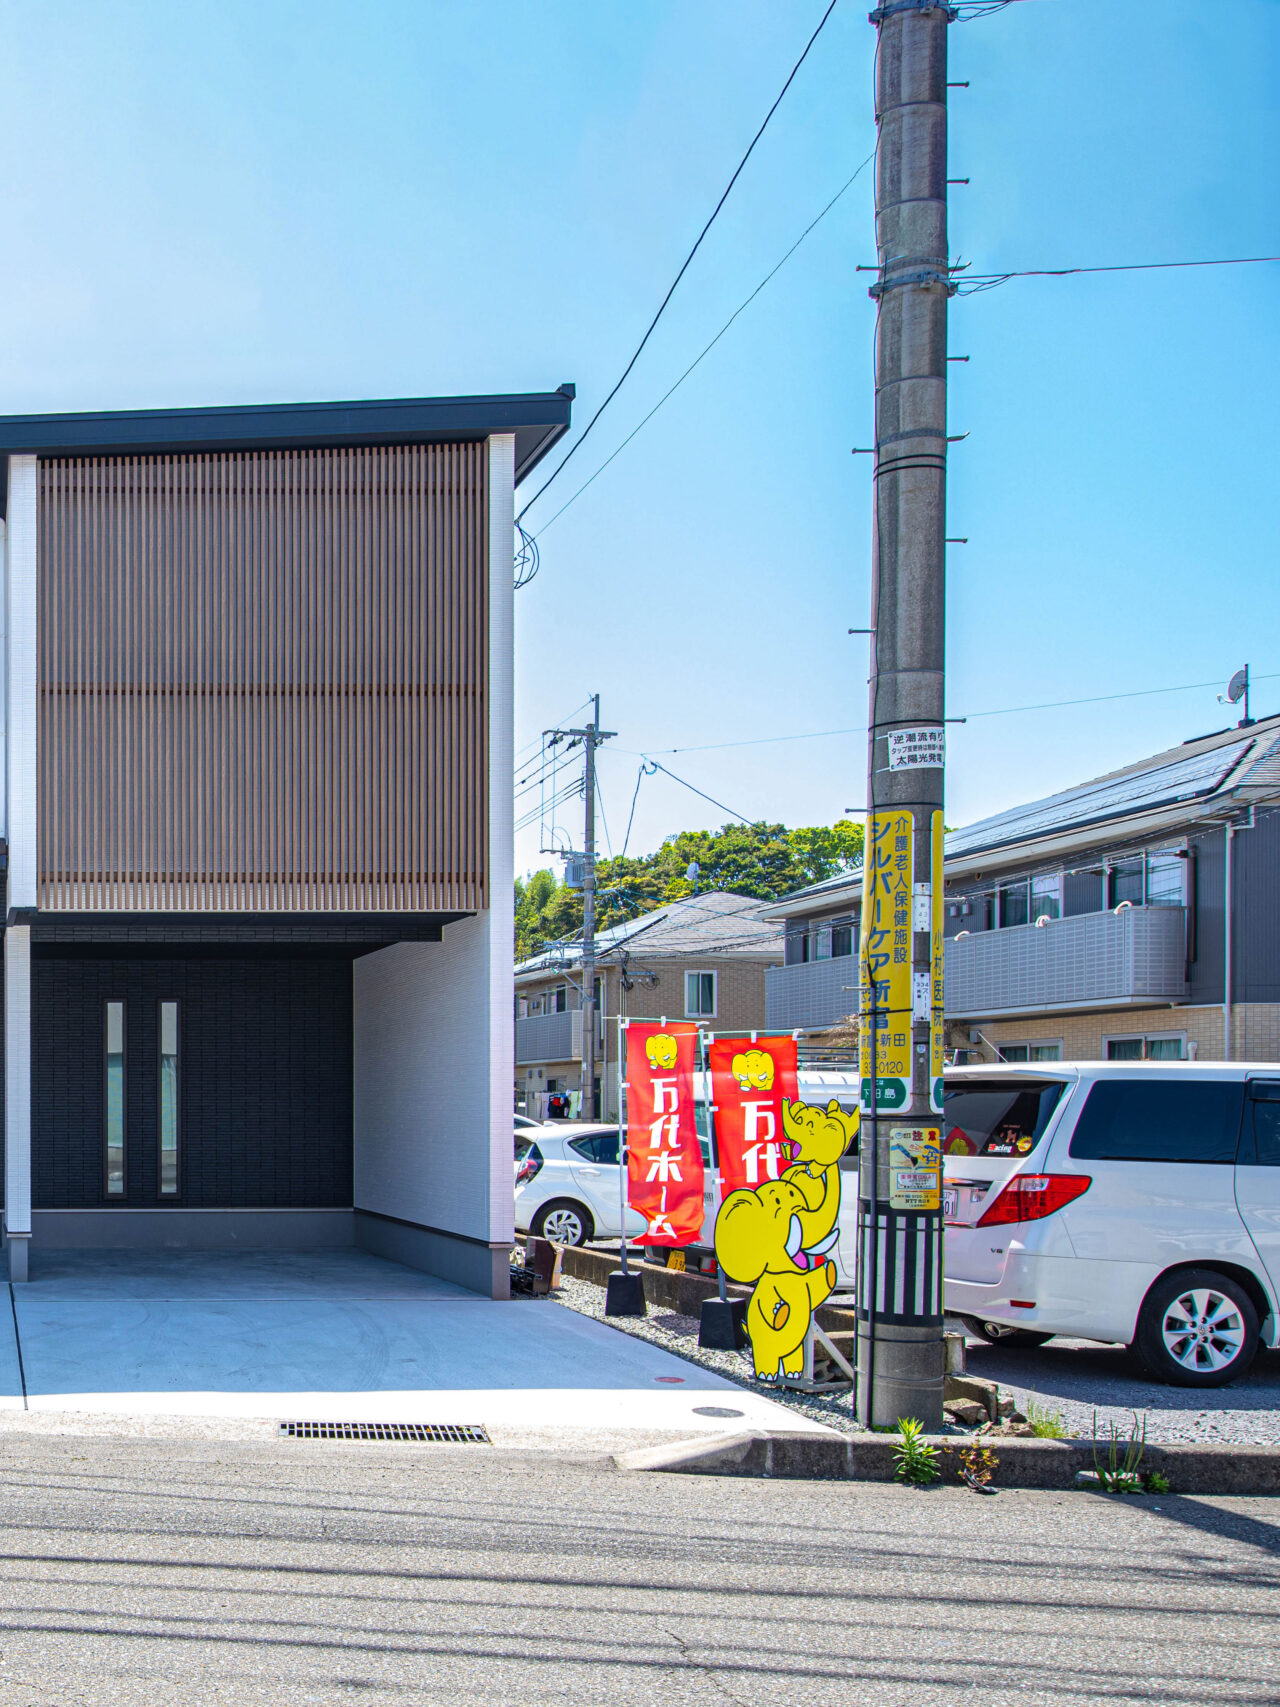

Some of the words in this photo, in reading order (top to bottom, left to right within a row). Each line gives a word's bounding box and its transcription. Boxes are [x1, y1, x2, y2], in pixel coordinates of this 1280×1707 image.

[897, 753, 942, 766] 太陽光発電
[868, 821, 893, 1029] シルバーケア新富
[894, 816, 909, 964] 介護老人保健施設
[645, 1077, 683, 1240] 万代ホーム
